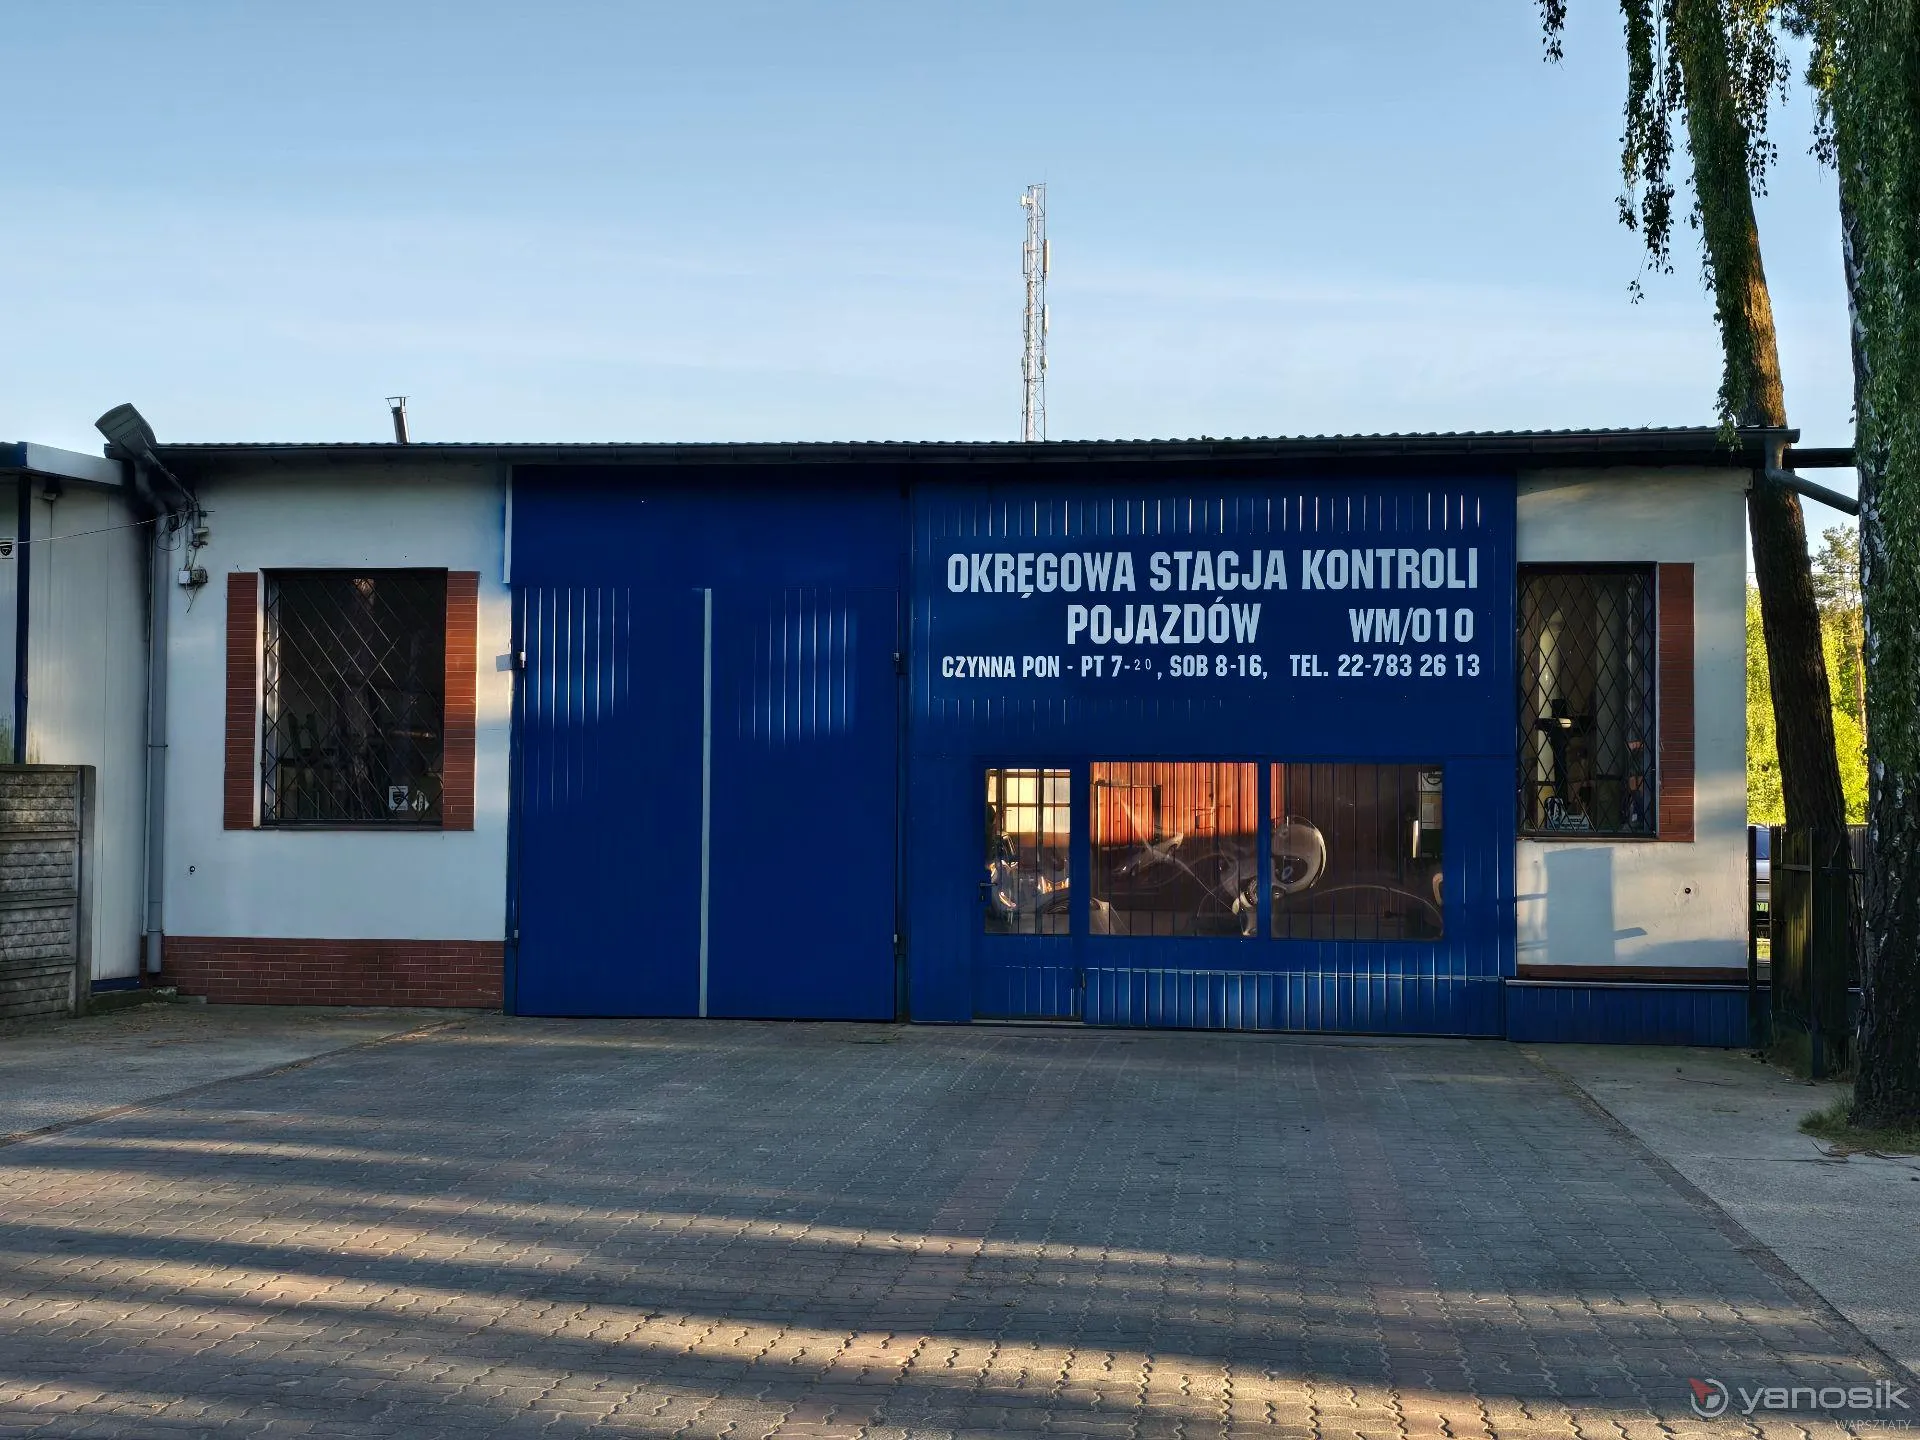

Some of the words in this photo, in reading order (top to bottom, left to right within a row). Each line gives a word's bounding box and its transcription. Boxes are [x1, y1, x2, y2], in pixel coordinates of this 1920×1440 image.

[947, 551, 1137, 599] OKRĘGOWA
[1149, 549, 1288, 592] STACJA
[1301, 547, 1478, 590] KONTROLI
[1067, 595, 1262, 645] POJAZDÓW
[1348, 607, 1474, 646] WM/010
[942, 655, 1017, 678] CZYNNA
[1022, 655, 1060, 678] PON
[1081, 655, 1105, 678] PT
[1169, 654, 1209, 677] SOB
[1215, 654, 1268, 680] 8-16,
[1289, 654, 1329, 677] TEL.
[1337, 653, 1413, 677] 22-783
[1419, 653, 1447, 677] 26
[1455, 653, 1480, 677] 13
